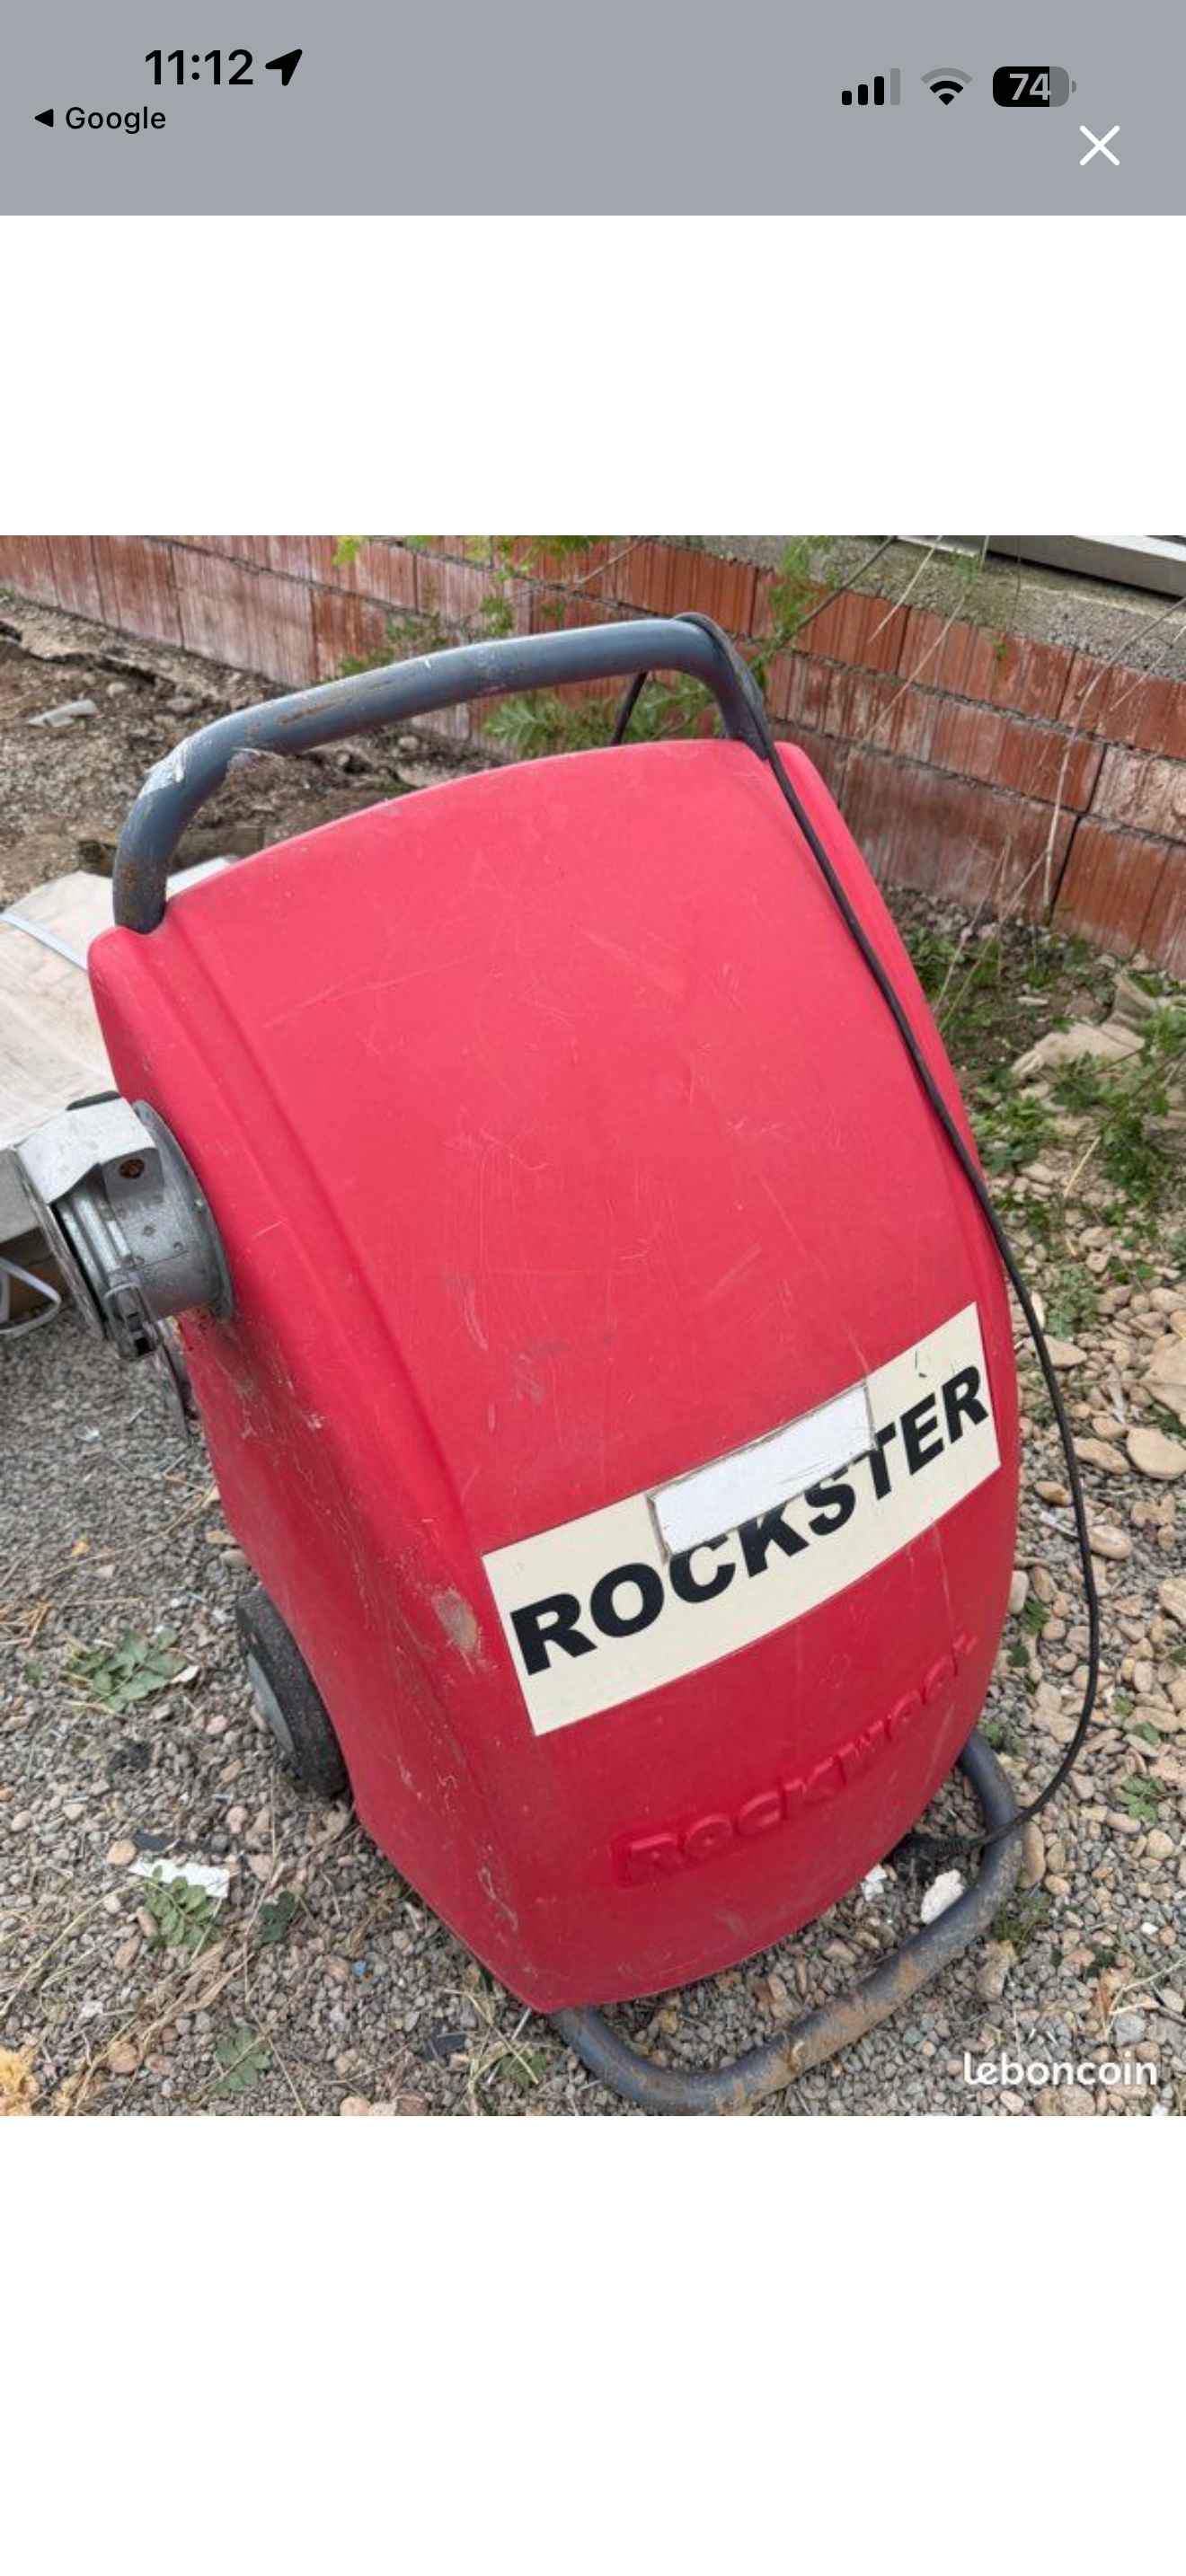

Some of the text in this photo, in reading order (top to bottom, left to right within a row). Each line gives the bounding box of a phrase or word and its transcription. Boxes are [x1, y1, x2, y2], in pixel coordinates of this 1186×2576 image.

[145, 49, 253, 85] 11:12
[1009, 73, 1052, 101] 74
[66, 106, 166, 135] Google
[509, 1365, 989, 1676] ROCKSTER
